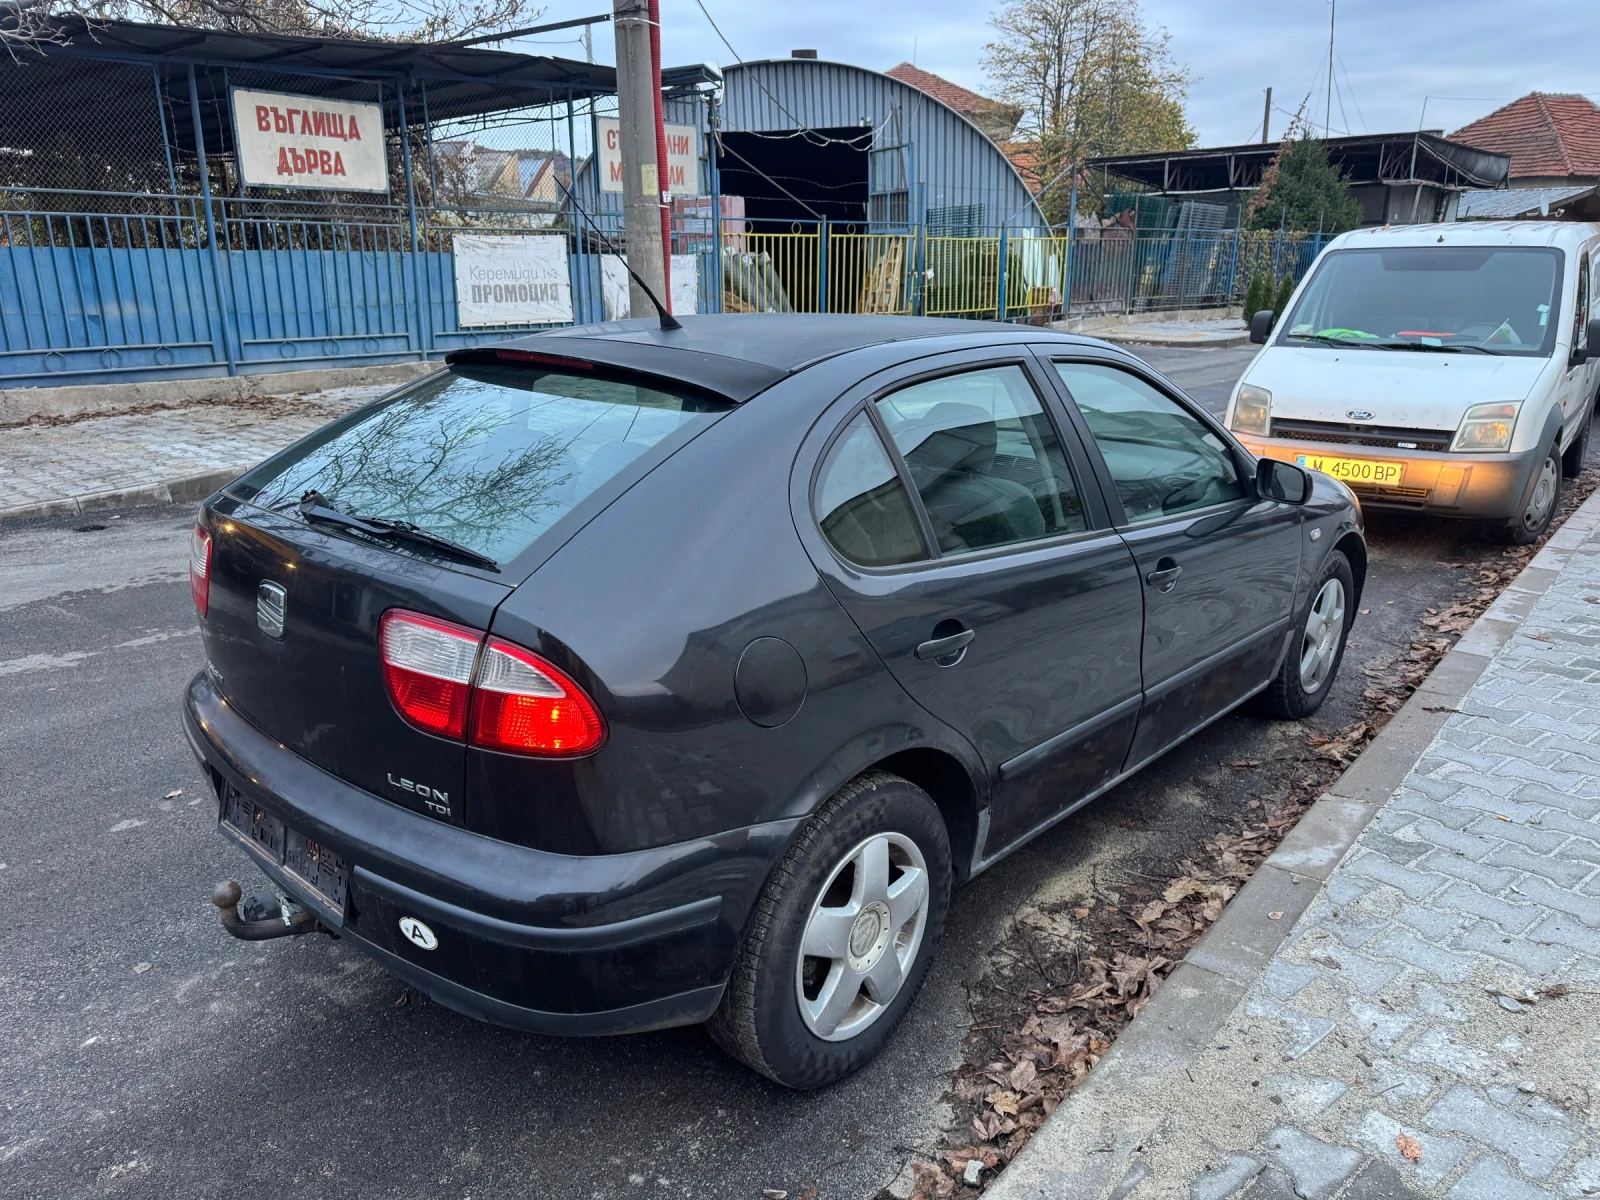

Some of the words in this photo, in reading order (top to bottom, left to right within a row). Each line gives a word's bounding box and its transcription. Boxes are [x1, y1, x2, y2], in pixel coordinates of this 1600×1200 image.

[255, 105, 361, 142] ВЪГЛИЩА
[277, 147, 347, 176] ДЪРВА
[469, 264, 538, 284] Керемиди
[543, 268, 557, 279] на
[471, 283, 560, 305] ПРОМОЦИЯ
[1332, 462, 1371, 478] 4500
[387, 772, 450, 805] LEON
[424, 800, 452, 817] TDI
[411, 924, 428, 946] A
